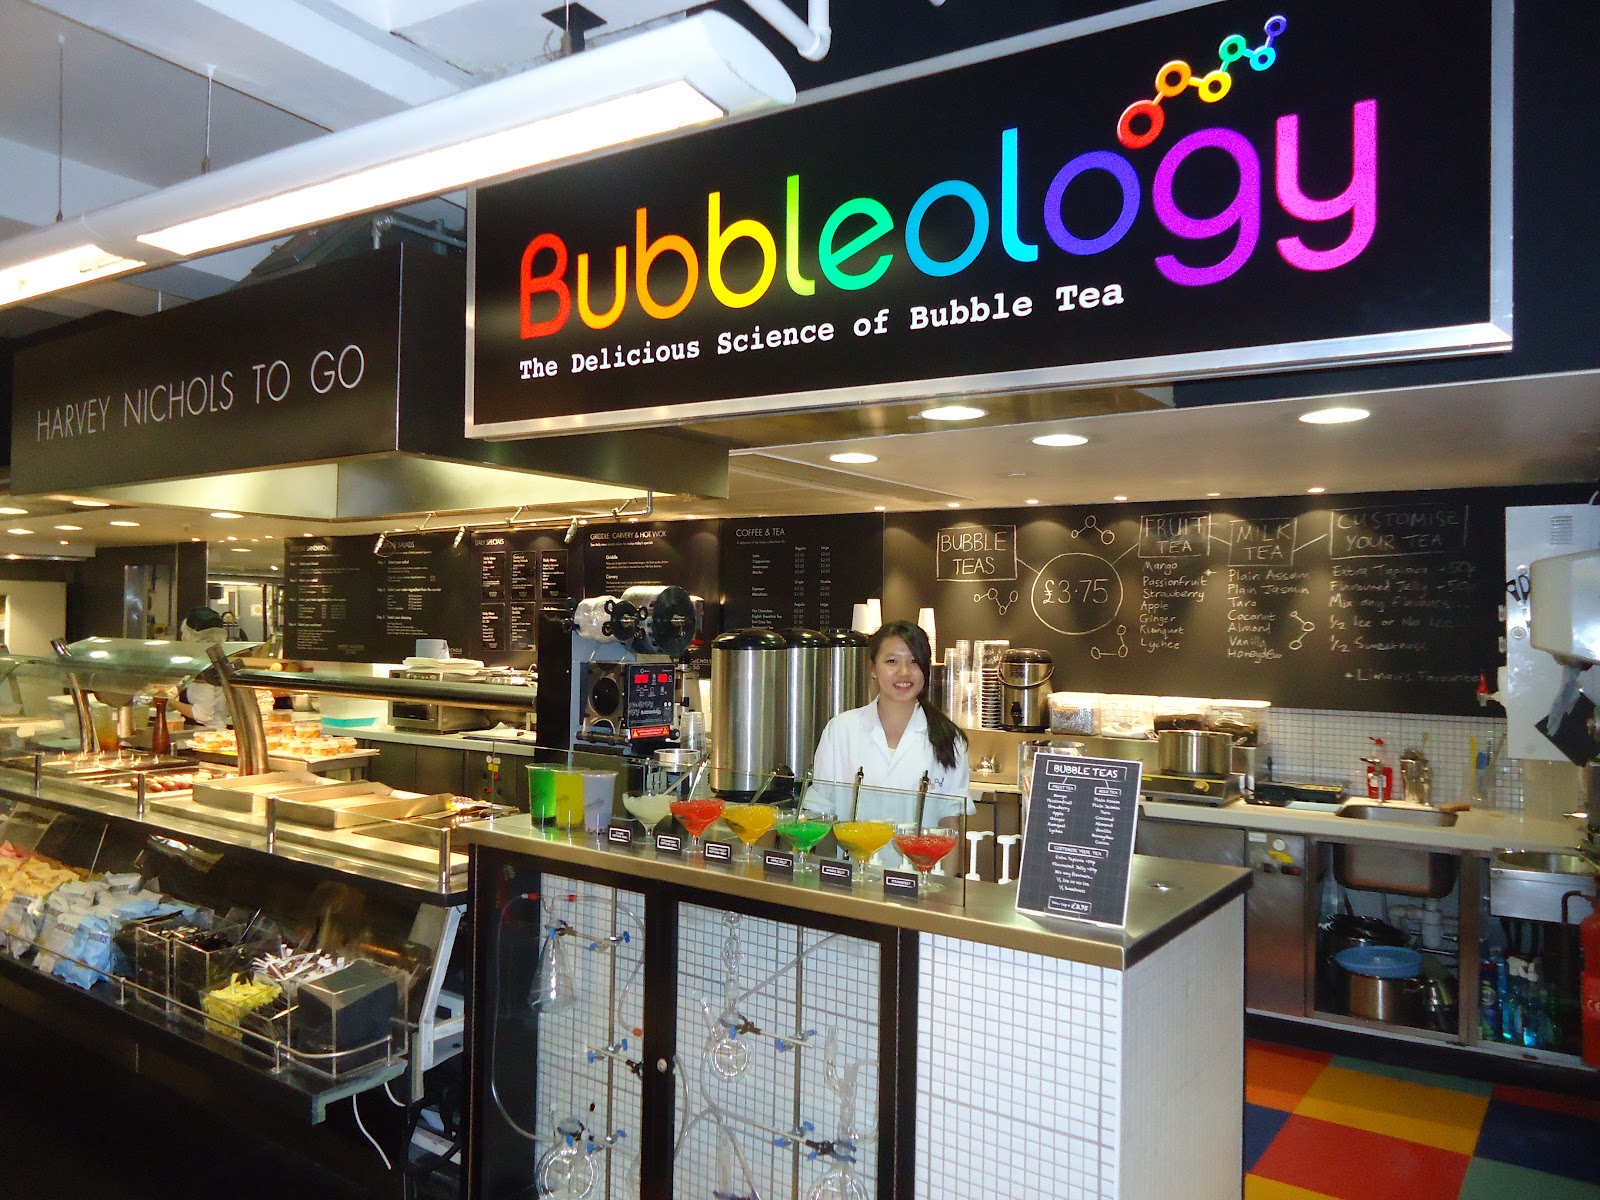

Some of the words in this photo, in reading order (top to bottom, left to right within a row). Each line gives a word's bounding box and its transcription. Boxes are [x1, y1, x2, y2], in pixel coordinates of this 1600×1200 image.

[520, 98, 1378, 339] Bubbleology
[519, 358, 558, 380] The
[571, 341, 700, 373] Delicious
[717, 324, 835, 355] Science
[852, 309, 890, 338] of
[909, 293, 1034, 330] Bubble
[1055, 284, 1125, 312] Tea
[36, 396, 111, 442] HARVEY
[123, 371, 234, 428] NICHOLS
[252, 360, 291, 404] TO
[310, 344, 365, 394] GO
[1145, 516, 1208, 538] FRUIT
[1338, 511, 1459, 530] CUSTOMISE
[640, 531, 652, 539] HOT
[652, 530, 667, 538] WOK
[736, 528, 763, 537] COFFEE
[765, 528, 771, 537] &
[772, 527, 786, 537] TEA
[1236, 523, 1292, 543] MILK
[941, 531, 1007, 552] BUBBLE
[1156, 540, 1193, 554] TEA
[1346, 534, 1396, 551] YOUR
[1402, 533, 1444, 547] TEA
[1244, 545, 1284, 560] TEA
[953, 557, 995, 576] TEAS
[1142, 561, 1178, 575] Mango
[1228, 568, 1261, 582] Plain
[1266, 569, 1310, 581] Assam
[1143, 589, 1205, 602] Strawberry
[1227, 583, 1258, 595] Plain
[1140, 602, 1169, 615] Apple
[1227, 596, 1257, 608] Taro
[1139, 614, 1177, 626] Ginger
[1227, 609, 1277, 622] Coconut
[1227, 623, 1272, 635] Almond
[1053, 764, 1090, 777] BUBBLE
[1092, 767, 1119, 780] TEAS
